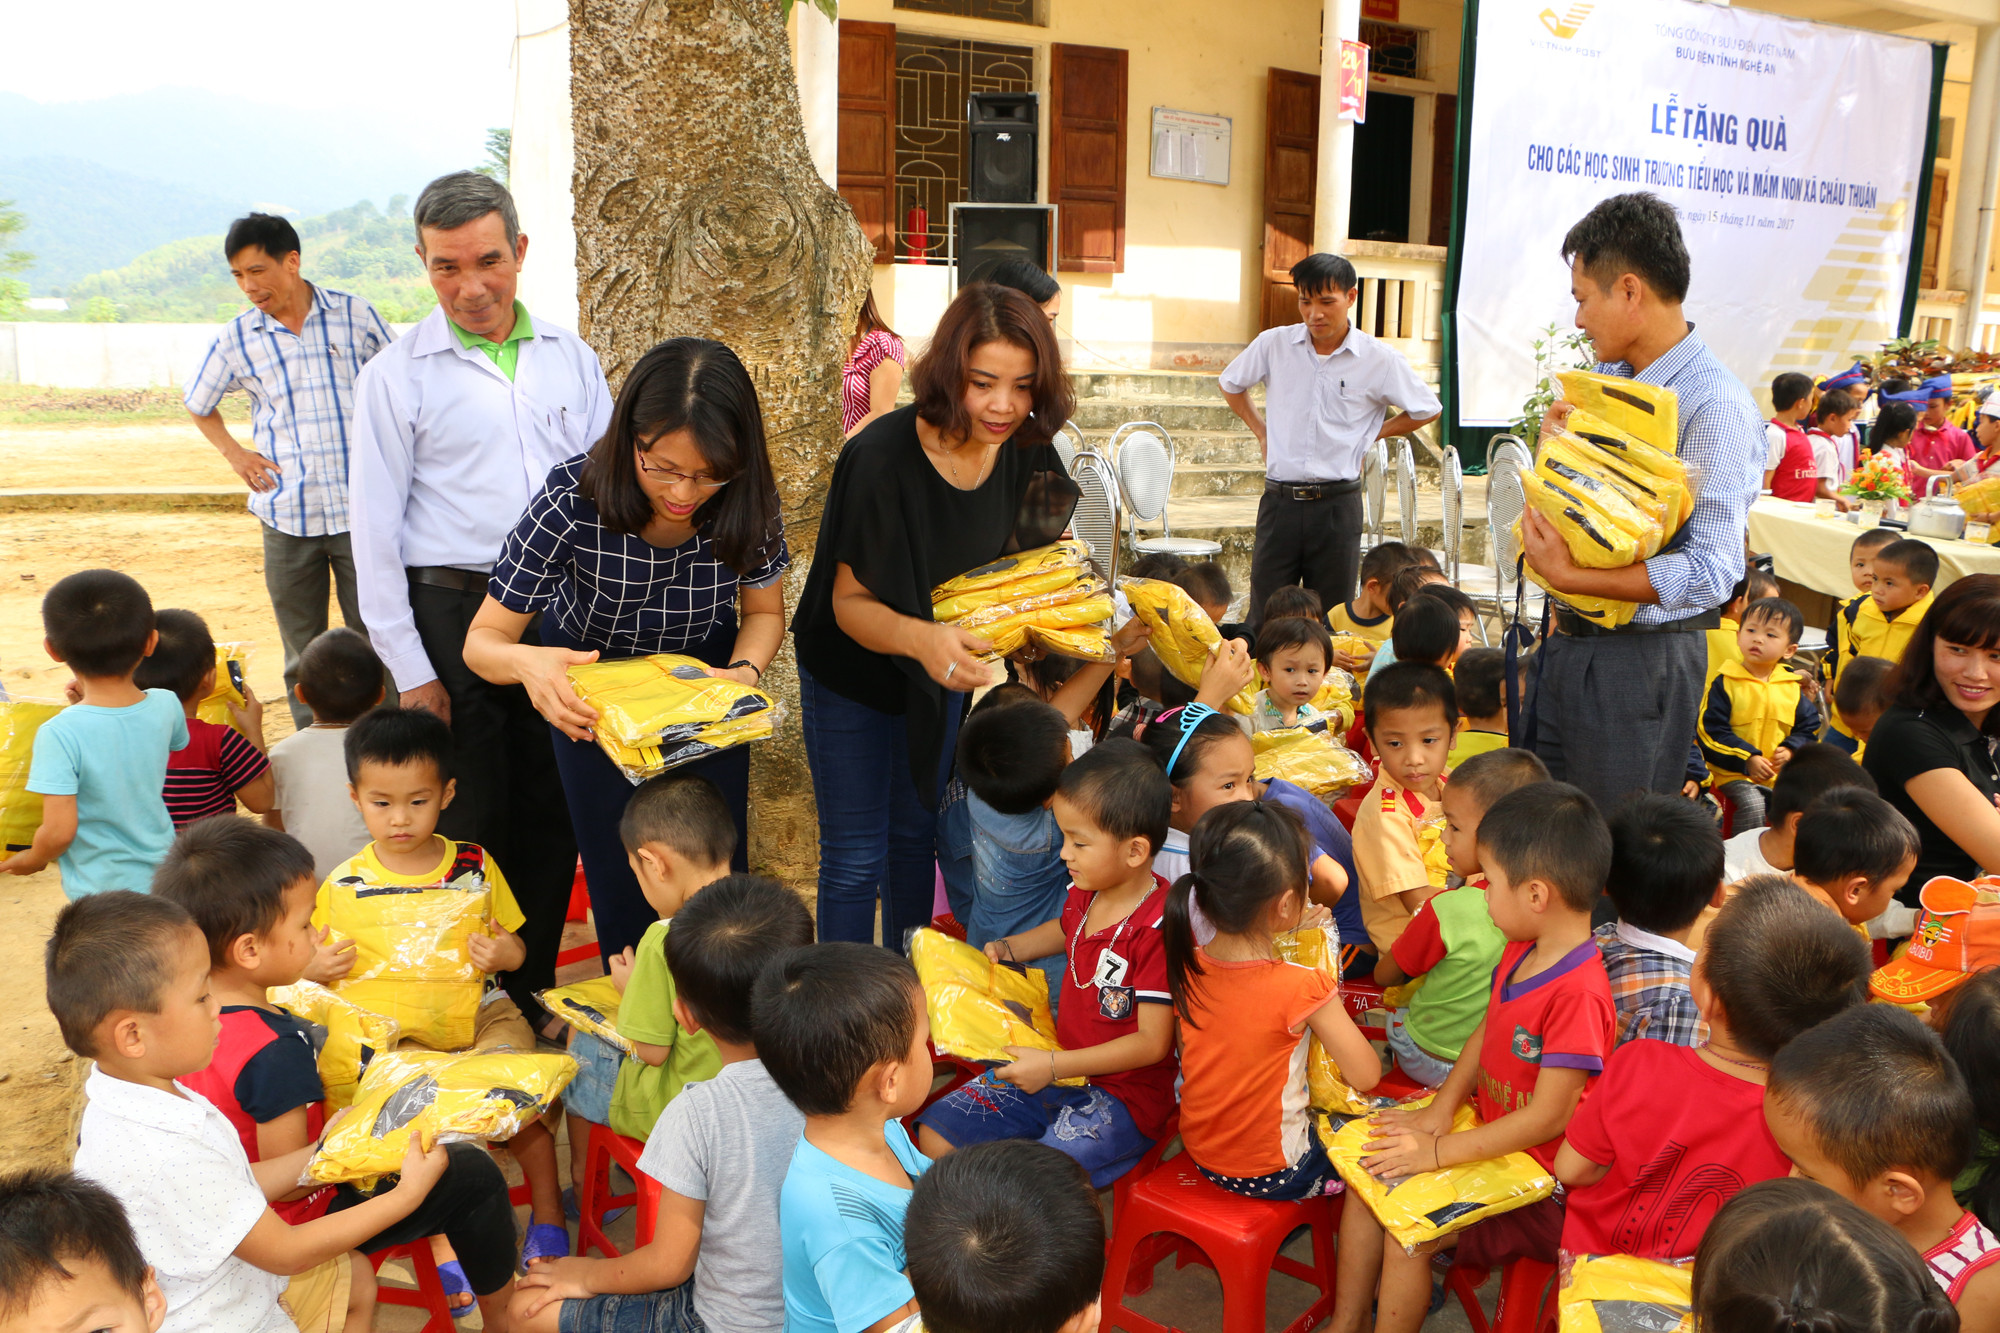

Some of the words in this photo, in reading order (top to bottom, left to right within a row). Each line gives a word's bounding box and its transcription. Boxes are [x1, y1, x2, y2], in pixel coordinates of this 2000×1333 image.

[1575, 46, 1602, 59] POST
[1675, 46, 1696, 61] BƯU
[1739, 58, 1763, 76] NGHỆ
[1763, 62, 1776, 76] AN
[1775, 46, 1796, 60] NAM
[1651, 93, 1679, 136] LỄ
[1682, 103, 1738, 148] TẶNG
[1746, 114, 1787, 152] QUÀ
[1527, 143, 1554, 172] CHO
[1556, 143, 1581, 176] CÁC
[1584, 151, 1609, 184] HỌC
[1611, 155, 1640, 183] SINH
[1712, 167, 1734, 199] HỌC
[1737, 166, 1750, 196] VÀ
[1781, 175, 1803, 201] NON
[1803, 175, 1817, 203] XÃ
[1687, 210, 1707, 225] ngày
[1708, 210, 1718, 222] 15
[1720, 212, 1744, 228] tháng
[1745, 214, 1756, 227] 11
[1757, 217, 1775, 229] năm
[1776, 217, 1795, 230] 2017
[1106, 958, 1121, 981] 7
